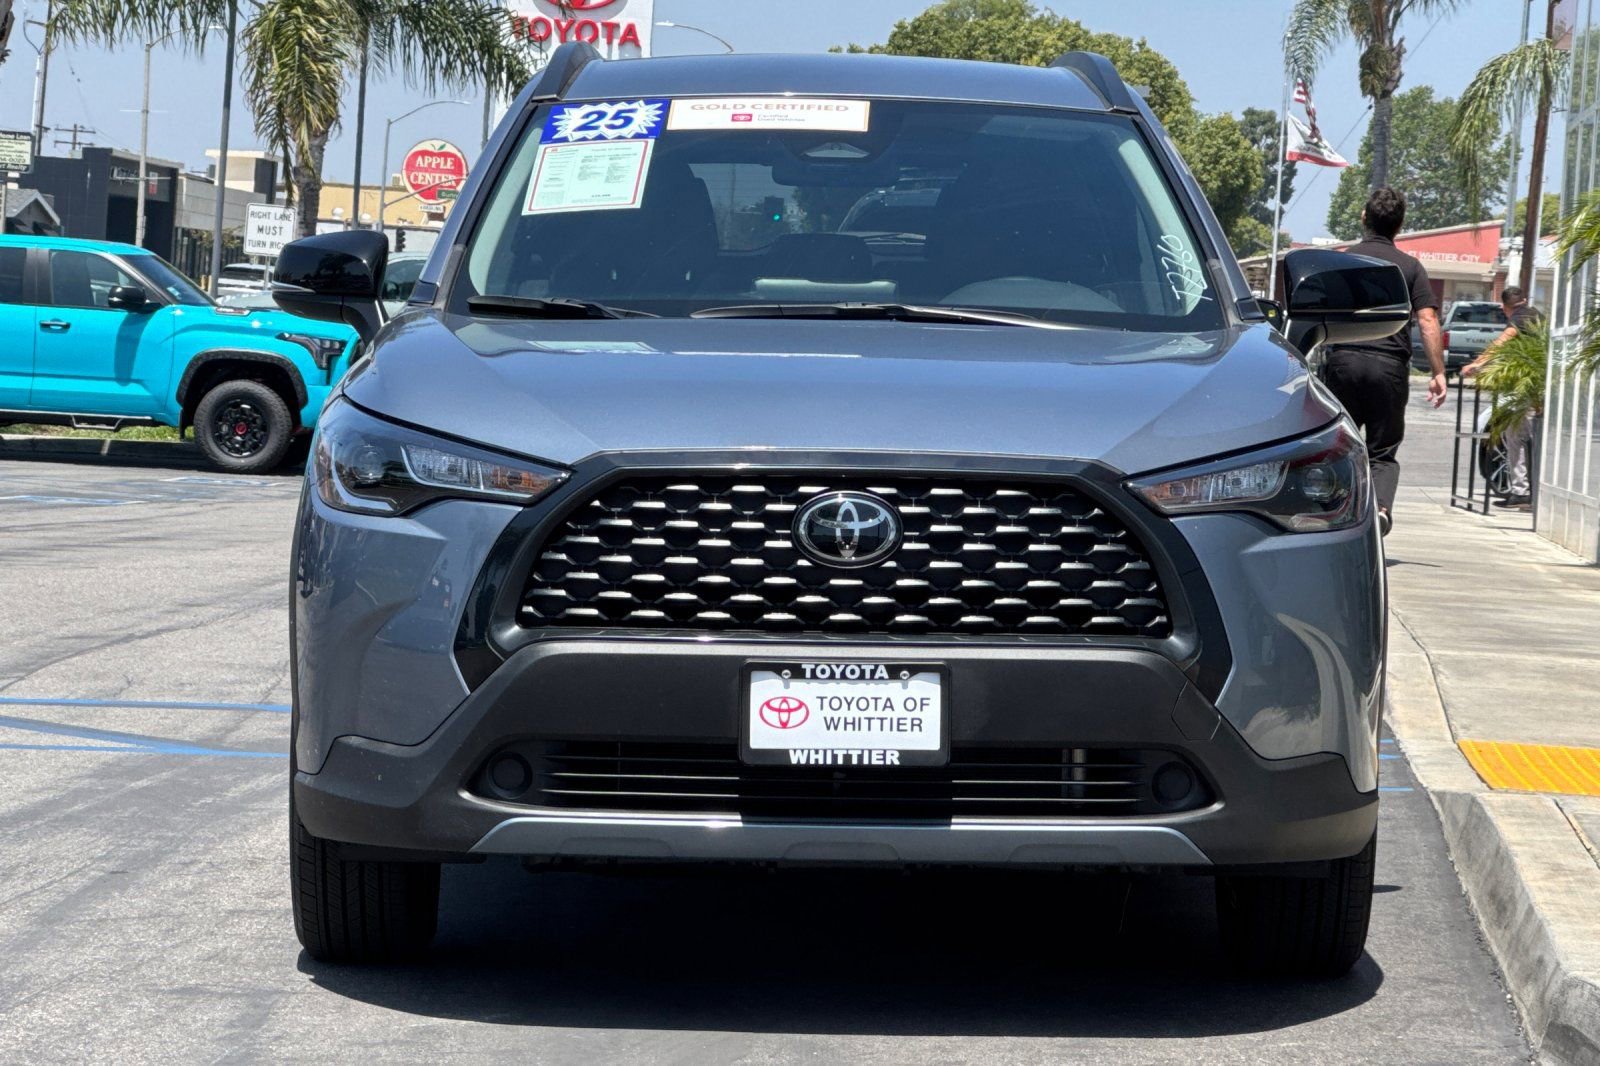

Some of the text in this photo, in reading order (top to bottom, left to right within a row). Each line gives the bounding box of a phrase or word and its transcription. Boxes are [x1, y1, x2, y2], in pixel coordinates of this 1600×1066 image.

[512, 16, 641, 47] TOYOTA
[690, 103, 849, 112] GOLD CERTIFIED
[572, 107, 640, 132] 25
[416, 155, 455, 169] APPLE
[410, 171, 457, 187] CENTER
[250, 211, 292, 221] RIGHT LANE
[257, 225, 284, 236] MUST
[248, 240, 285, 250] TURN RIG
[801, 664, 889, 679] TOYOTA
[816, 696, 931, 712] TOYOTA OF
[823, 716, 923, 732] WHITTIER
[789, 749, 900, 765] WHITTIER
